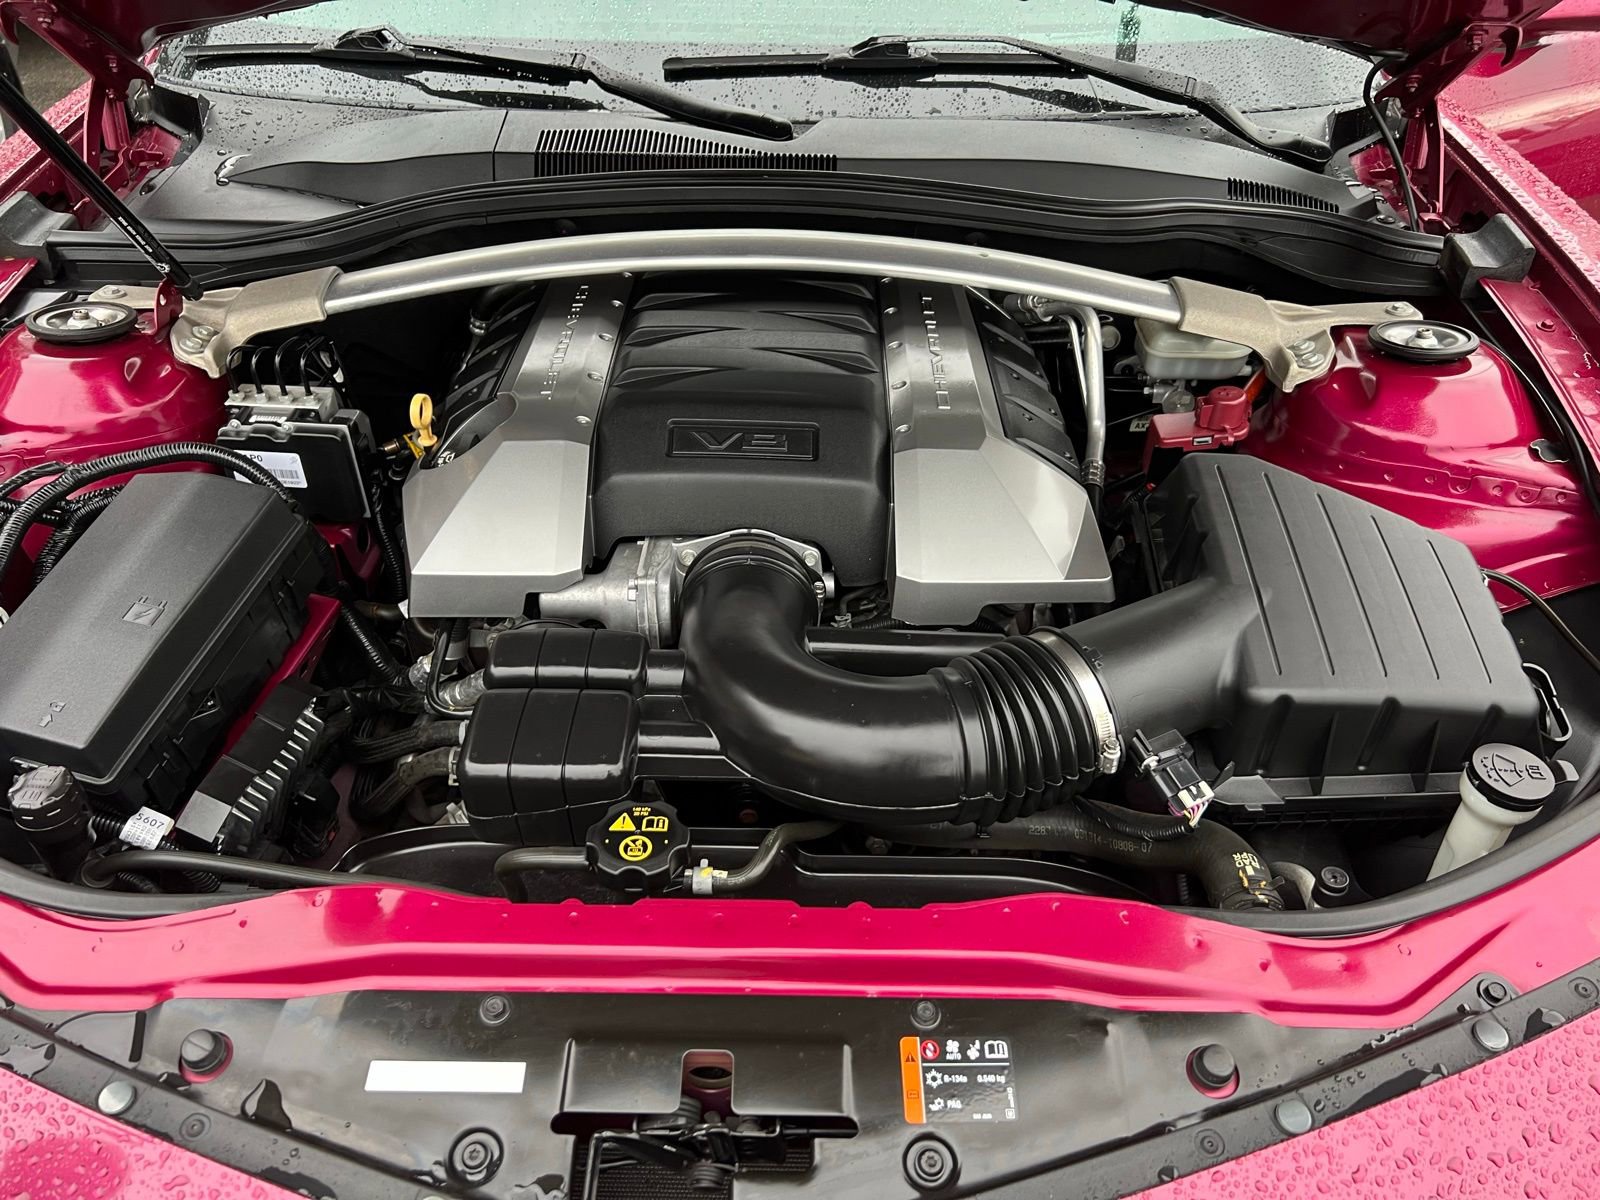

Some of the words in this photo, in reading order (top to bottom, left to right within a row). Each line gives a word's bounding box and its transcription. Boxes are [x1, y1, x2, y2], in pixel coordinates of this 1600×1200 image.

[541, 285, 589, 400] CHEVROLET
[919, 292, 951, 410] CHEVROLET
[689, 431, 788, 453] V8
[136, 812, 165, 829] 5607
[946, 1052, 962, 1060] AUTO
[943, 1074, 968, 1083] R-134a
